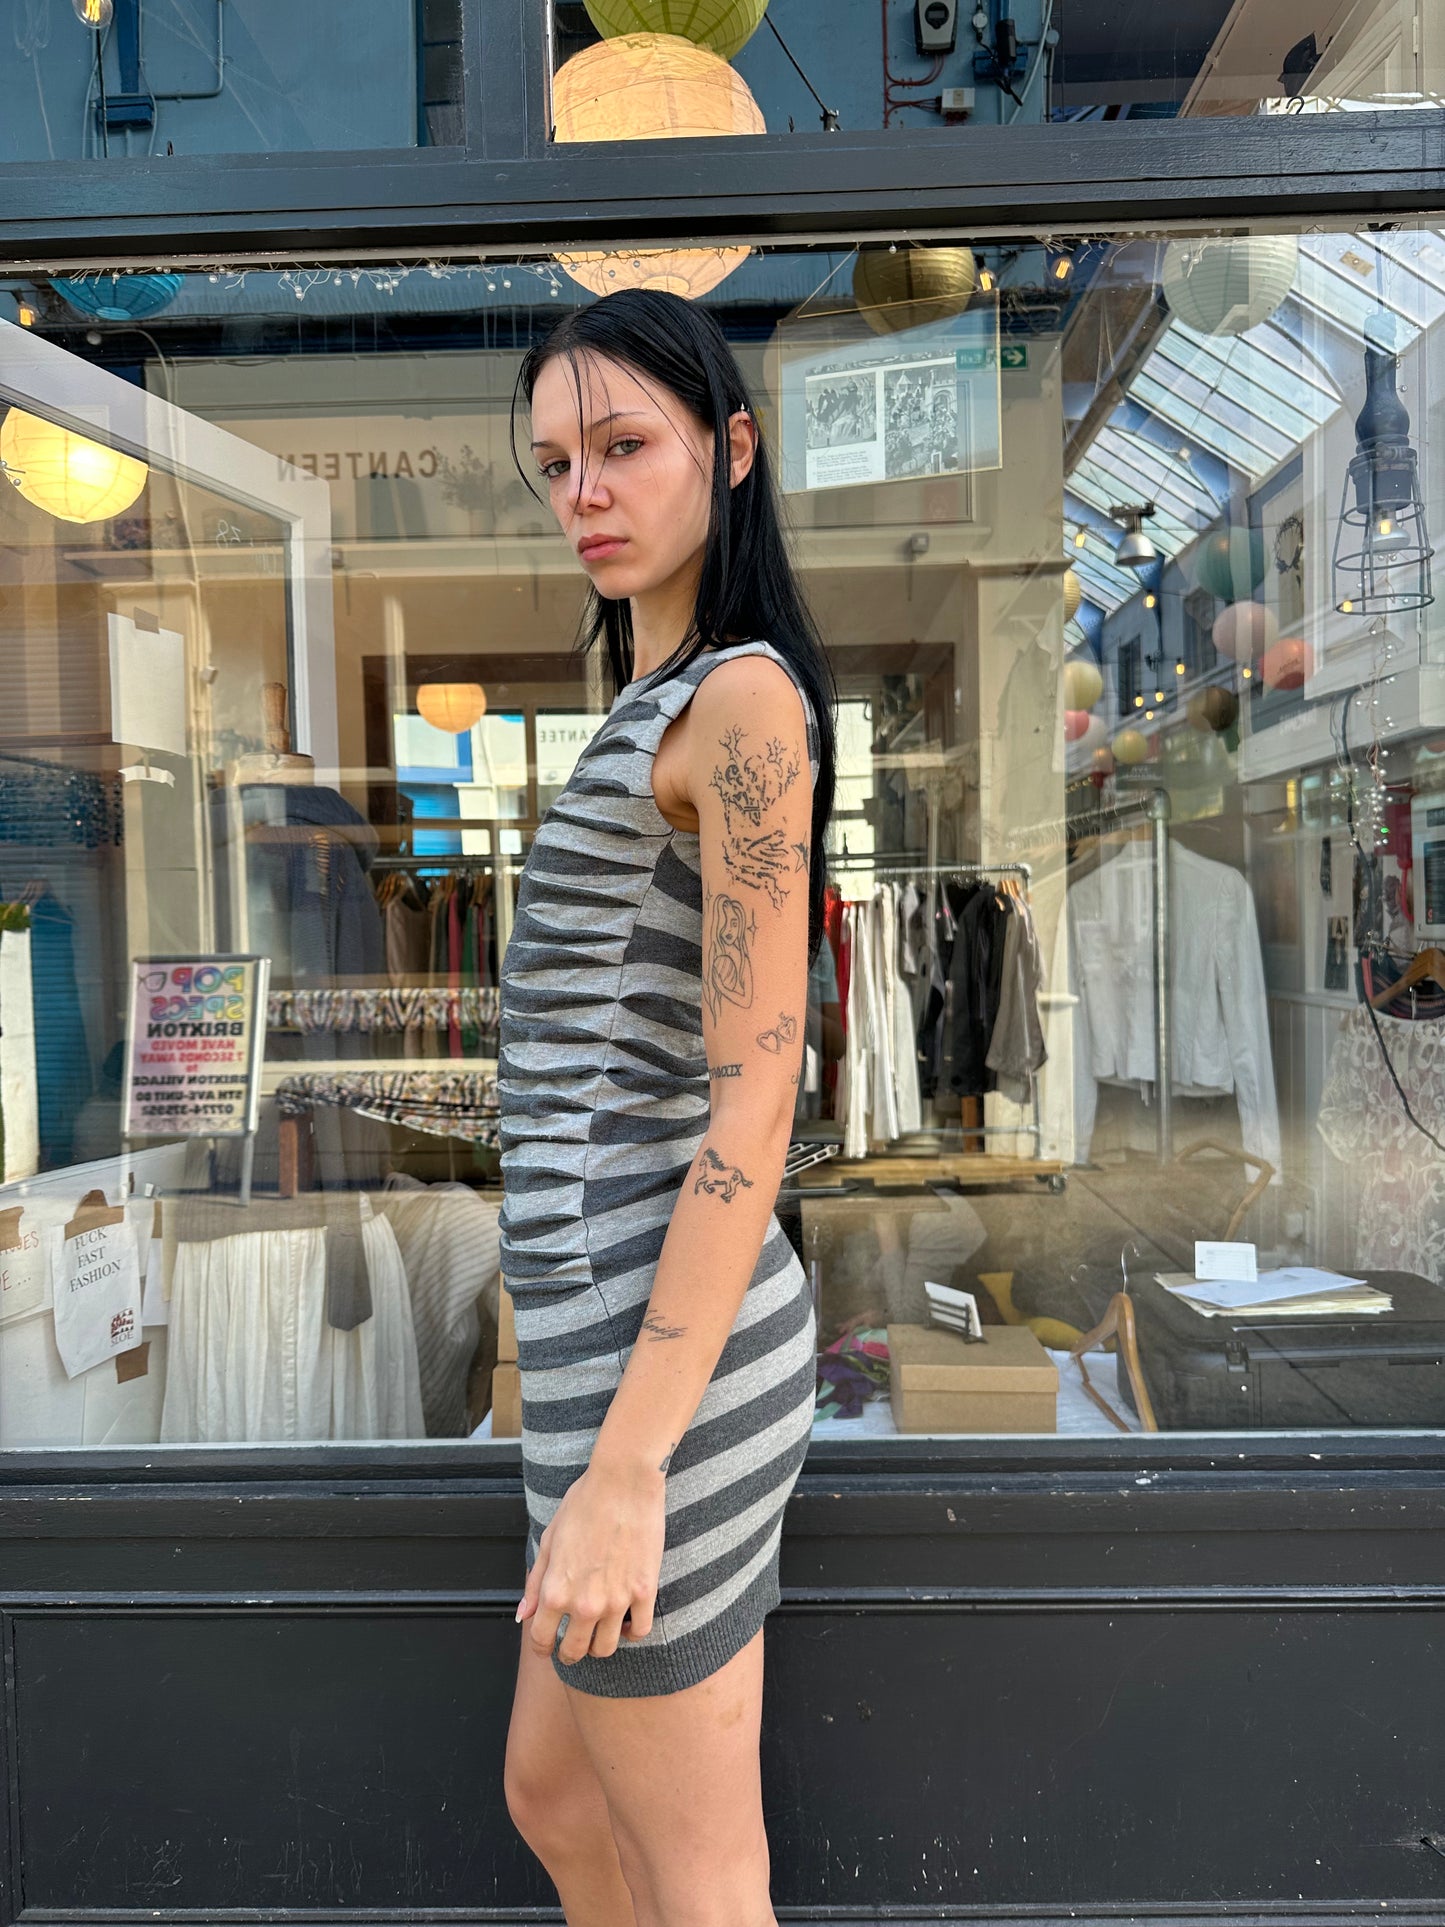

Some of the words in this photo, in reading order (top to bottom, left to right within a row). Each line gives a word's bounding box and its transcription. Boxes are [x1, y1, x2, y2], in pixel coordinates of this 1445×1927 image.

[74, 1226, 108, 1250] FUCK
[77, 1246, 106, 1269] FAST
[69, 1258, 122, 1293] FASHION
